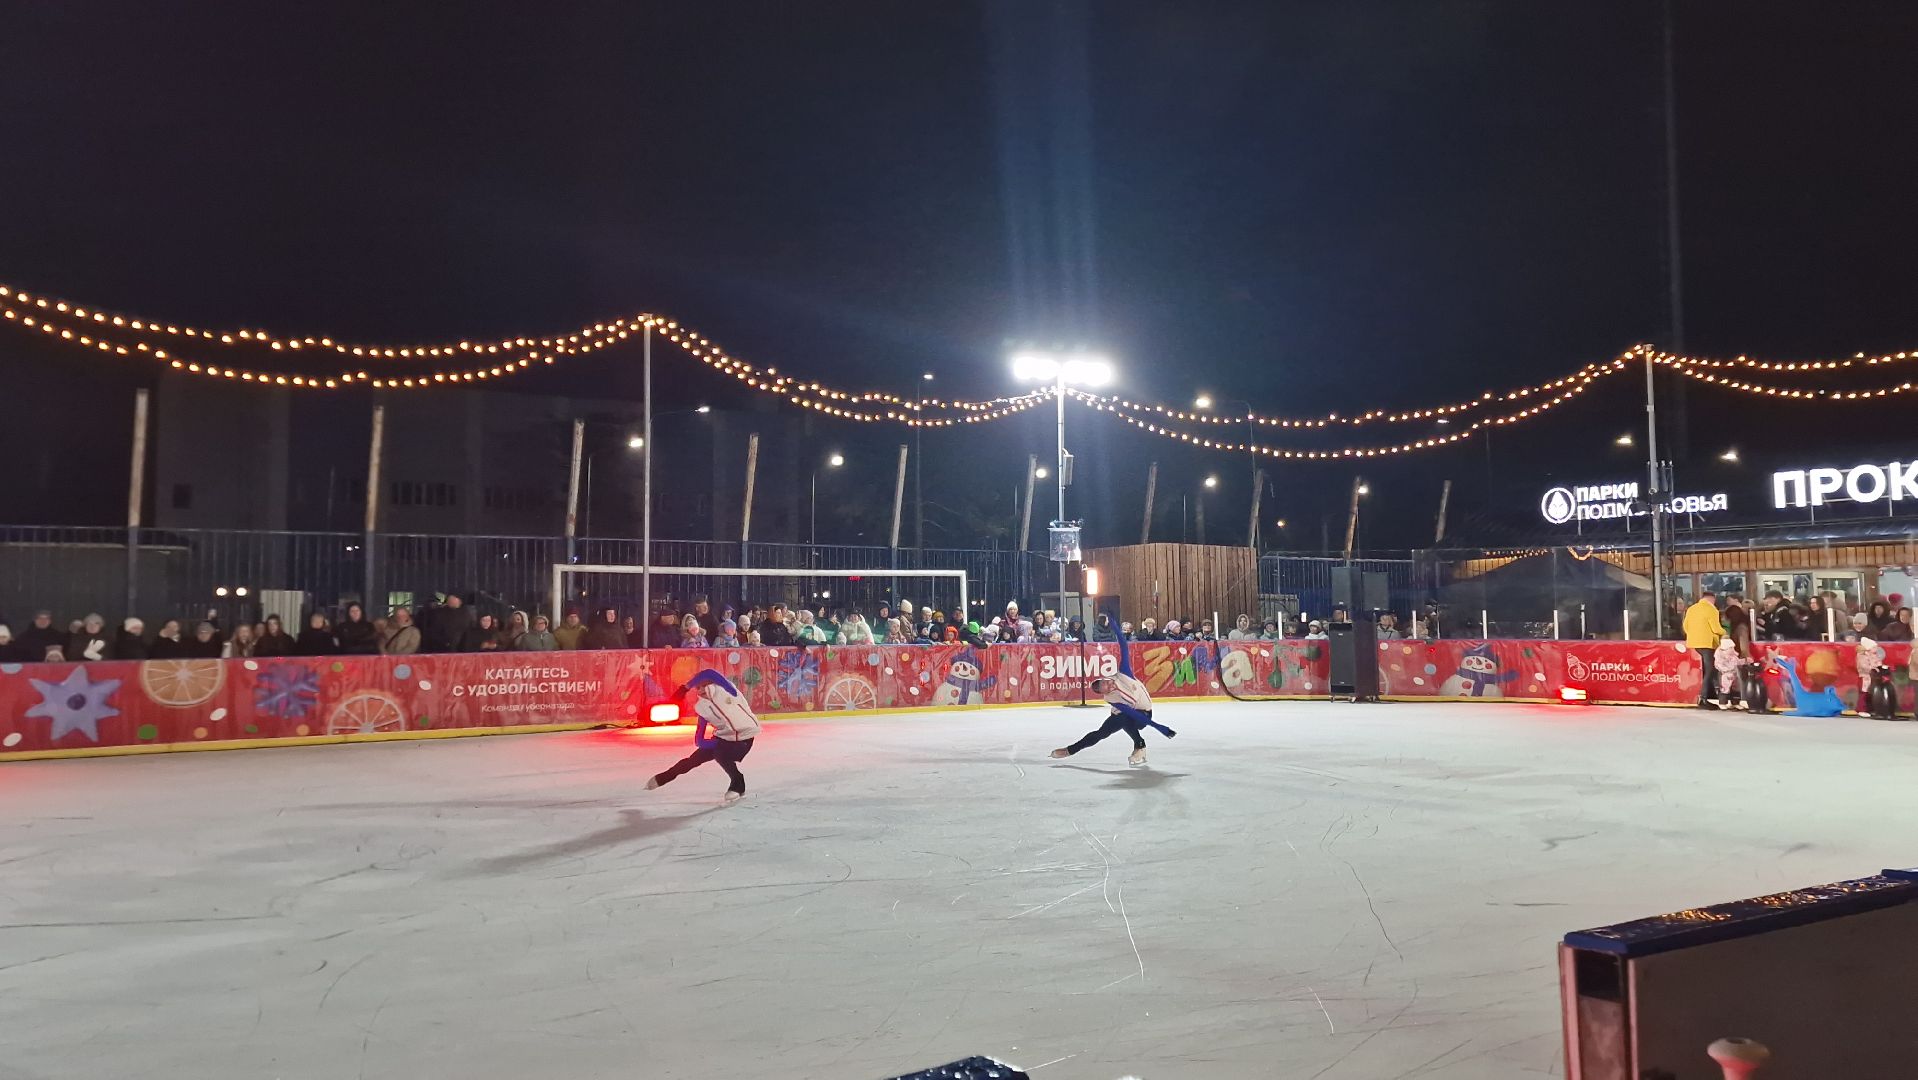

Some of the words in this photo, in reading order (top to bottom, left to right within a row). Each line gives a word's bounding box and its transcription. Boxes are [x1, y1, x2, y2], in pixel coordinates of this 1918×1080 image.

[1576, 482, 1639, 502] ПАРКИ
[1577, 493, 1728, 520] ПОДМКОВЬЯ
[485, 665, 570, 681] КАТАЙТЕСЬ
[1591, 662, 1630, 672] ПАРКИ
[1591, 672, 1682, 683] ПОДМОСКОВЬЯ
[452, 685, 465, 697] С
[467, 680, 602, 697] УДОВОЛЬСТВИЕМ!
